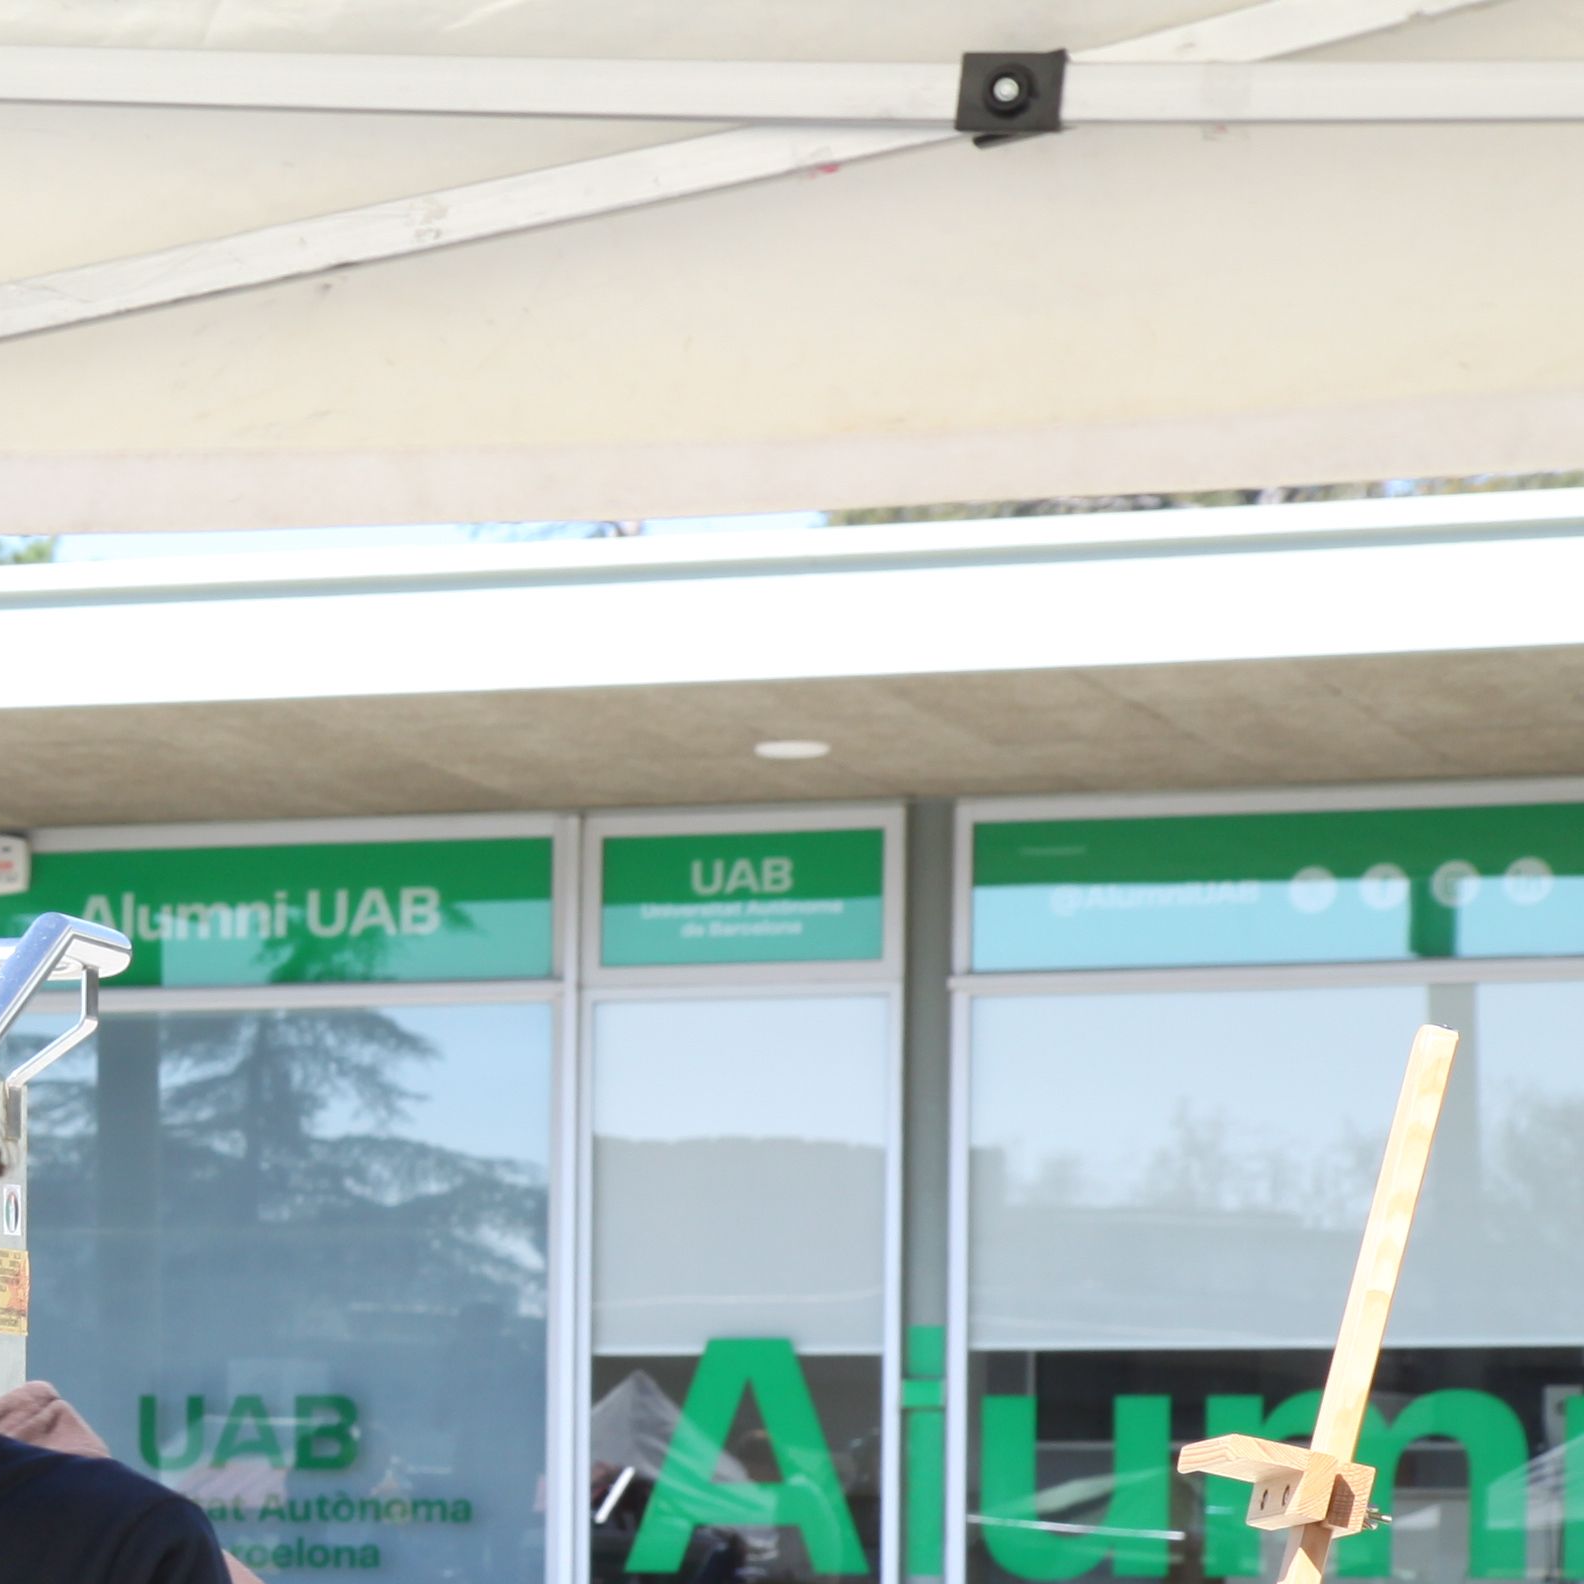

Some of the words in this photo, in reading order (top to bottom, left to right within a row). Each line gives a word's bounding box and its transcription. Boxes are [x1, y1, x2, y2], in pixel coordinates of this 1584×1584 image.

[691, 857, 793, 895] UAB
[306, 886, 442, 939] UAB
[138, 1394, 359, 1471] UAB
